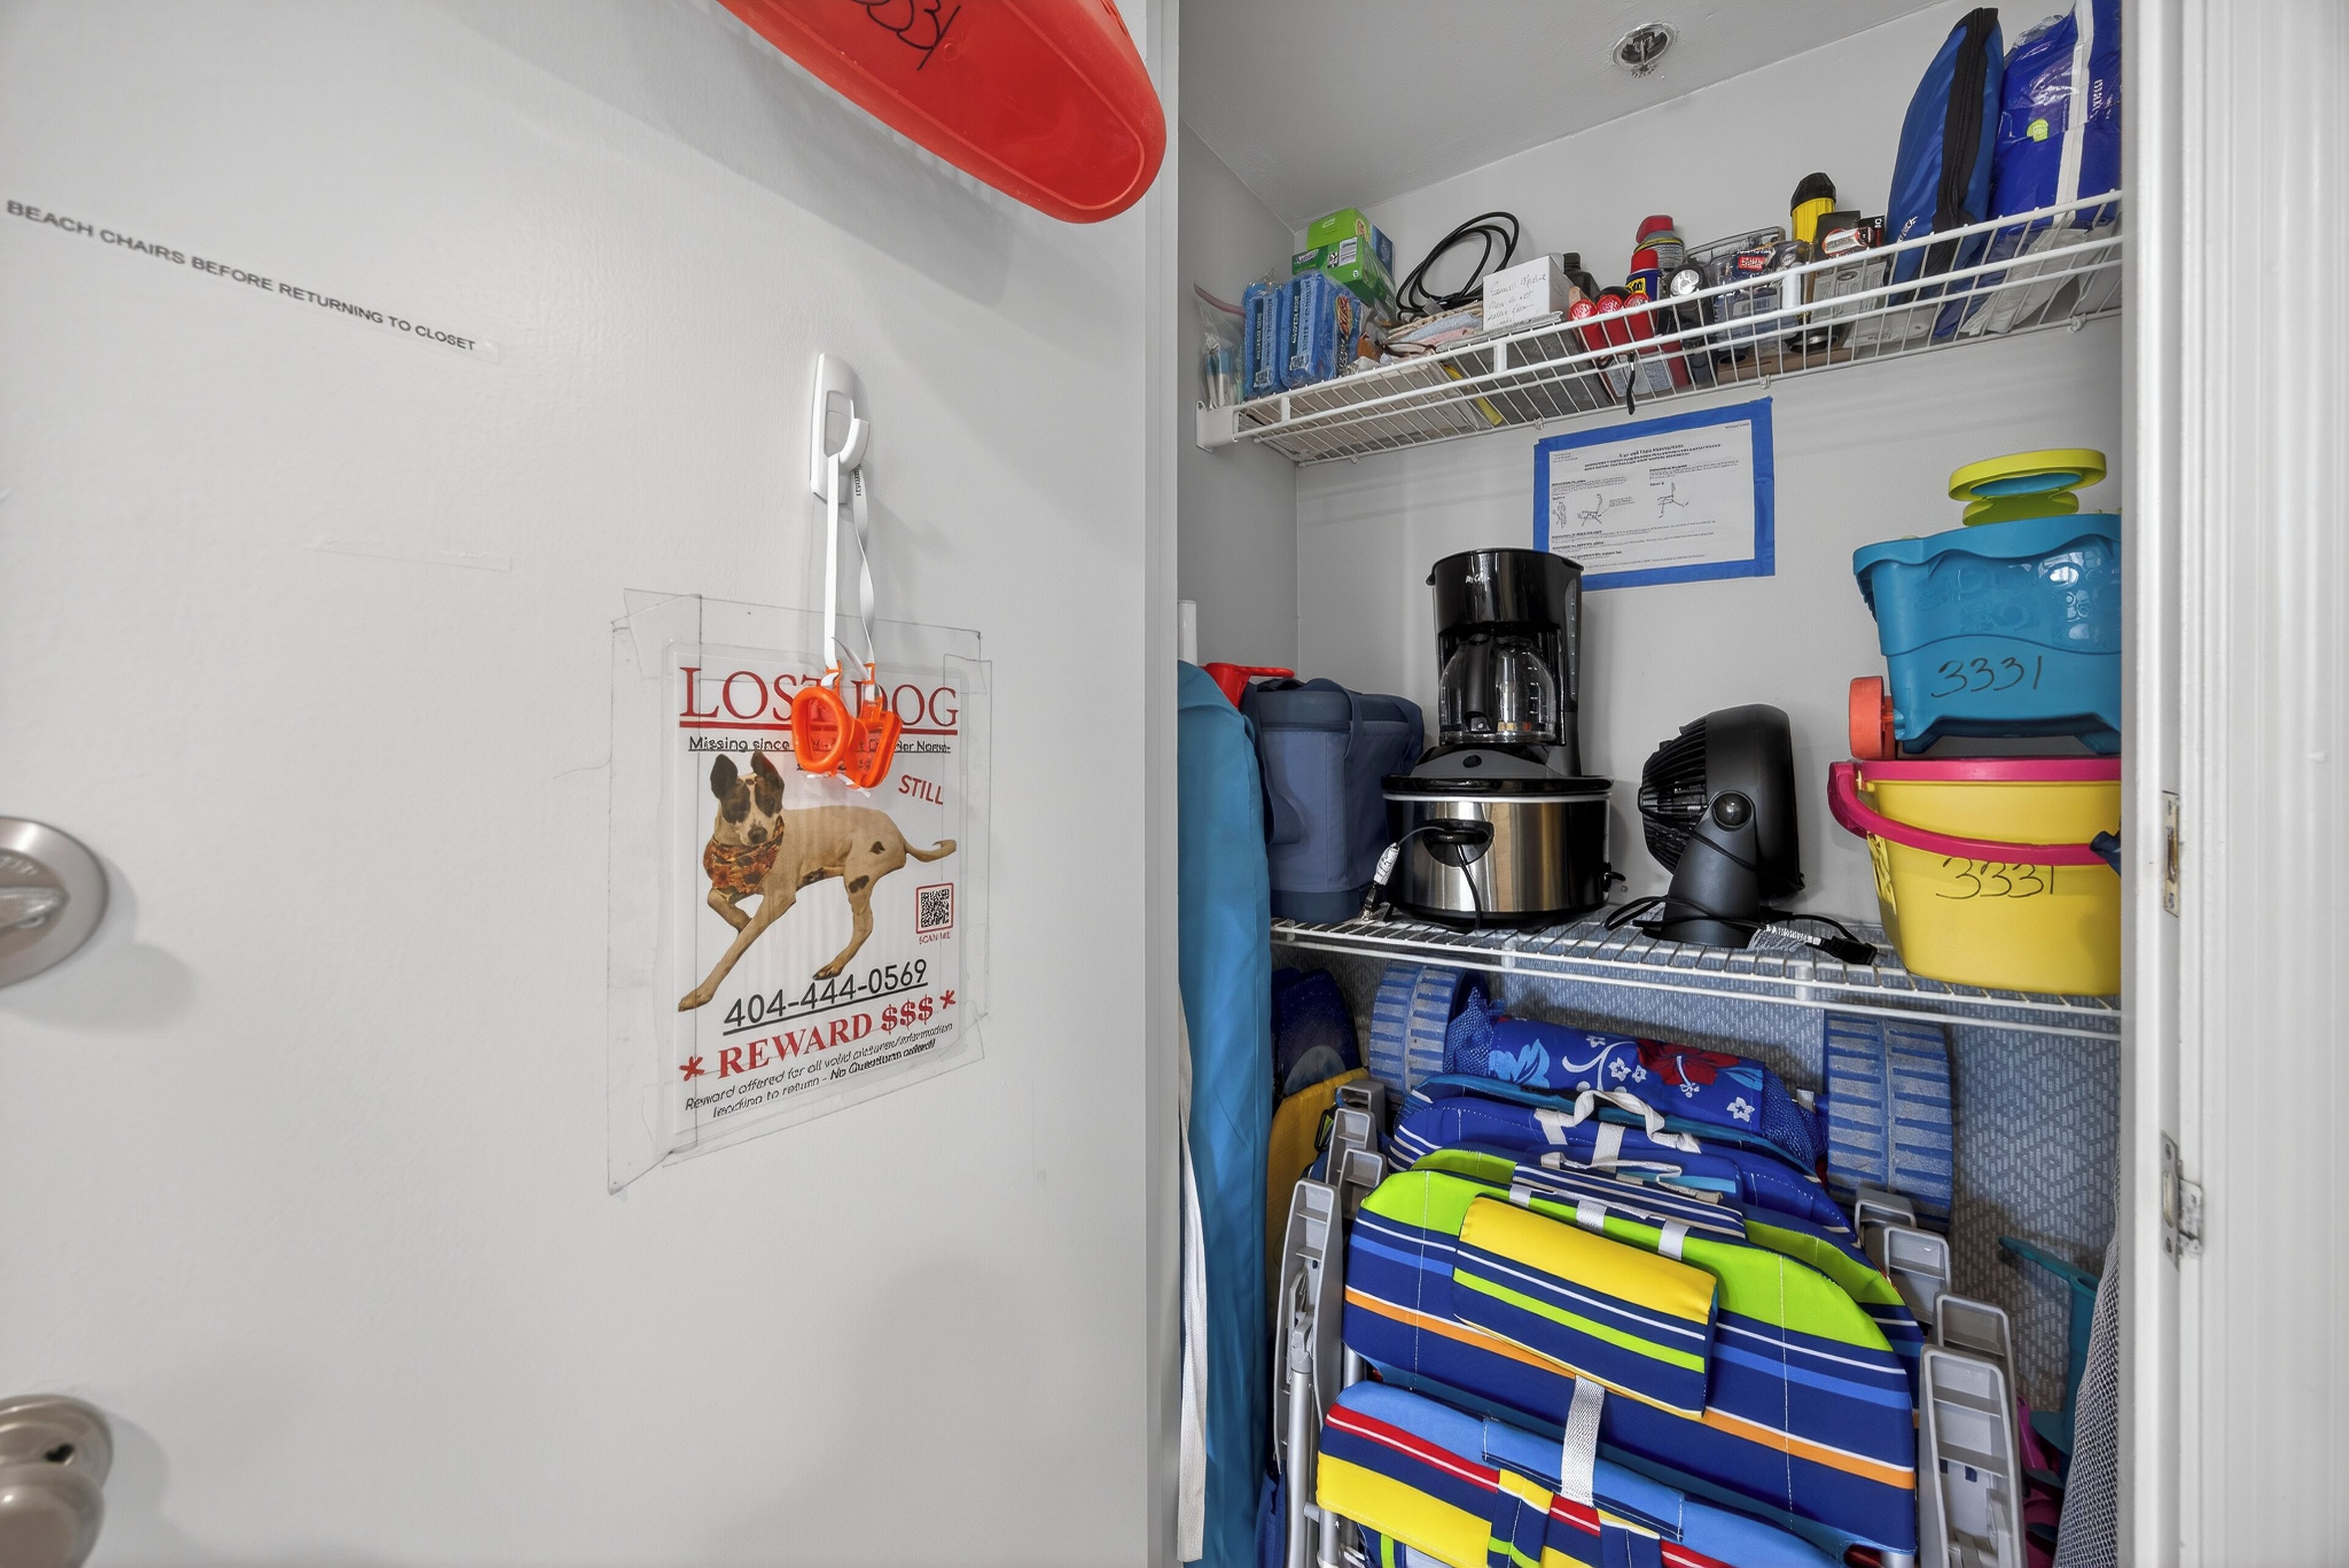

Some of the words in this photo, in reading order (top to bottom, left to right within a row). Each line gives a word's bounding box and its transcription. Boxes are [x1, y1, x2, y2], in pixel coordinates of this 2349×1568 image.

[7, 199, 94, 237] BEACH
[100, 229, 185, 265] CHAIRS
[191, 256, 274, 291] BEFORE
[279, 282, 384, 324] RETURNING
[388, 316, 411, 332] TO
[415, 325, 475, 351] CLOSET
[1931, 655, 2043, 698] 3331
[851, 680, 959, 727] DOG
[689, 735, 749, 752] Missing
[898, 774, 943, 805] STILL
[1935, 857, 2054, 900] 3331
[723, 958, 927, 1028] 404-444-0569
[716, 1012, 873, 1080] REWARD
[880, 994, 934, 1035] $$$
[685, 1085, 735, 1111] Reward
[787, 1066, 805, 1080] for
[807, 1059, 822, 1074] all
[766, 1089, 779, 1101] to
[830, 1068, 846, 1080] No
